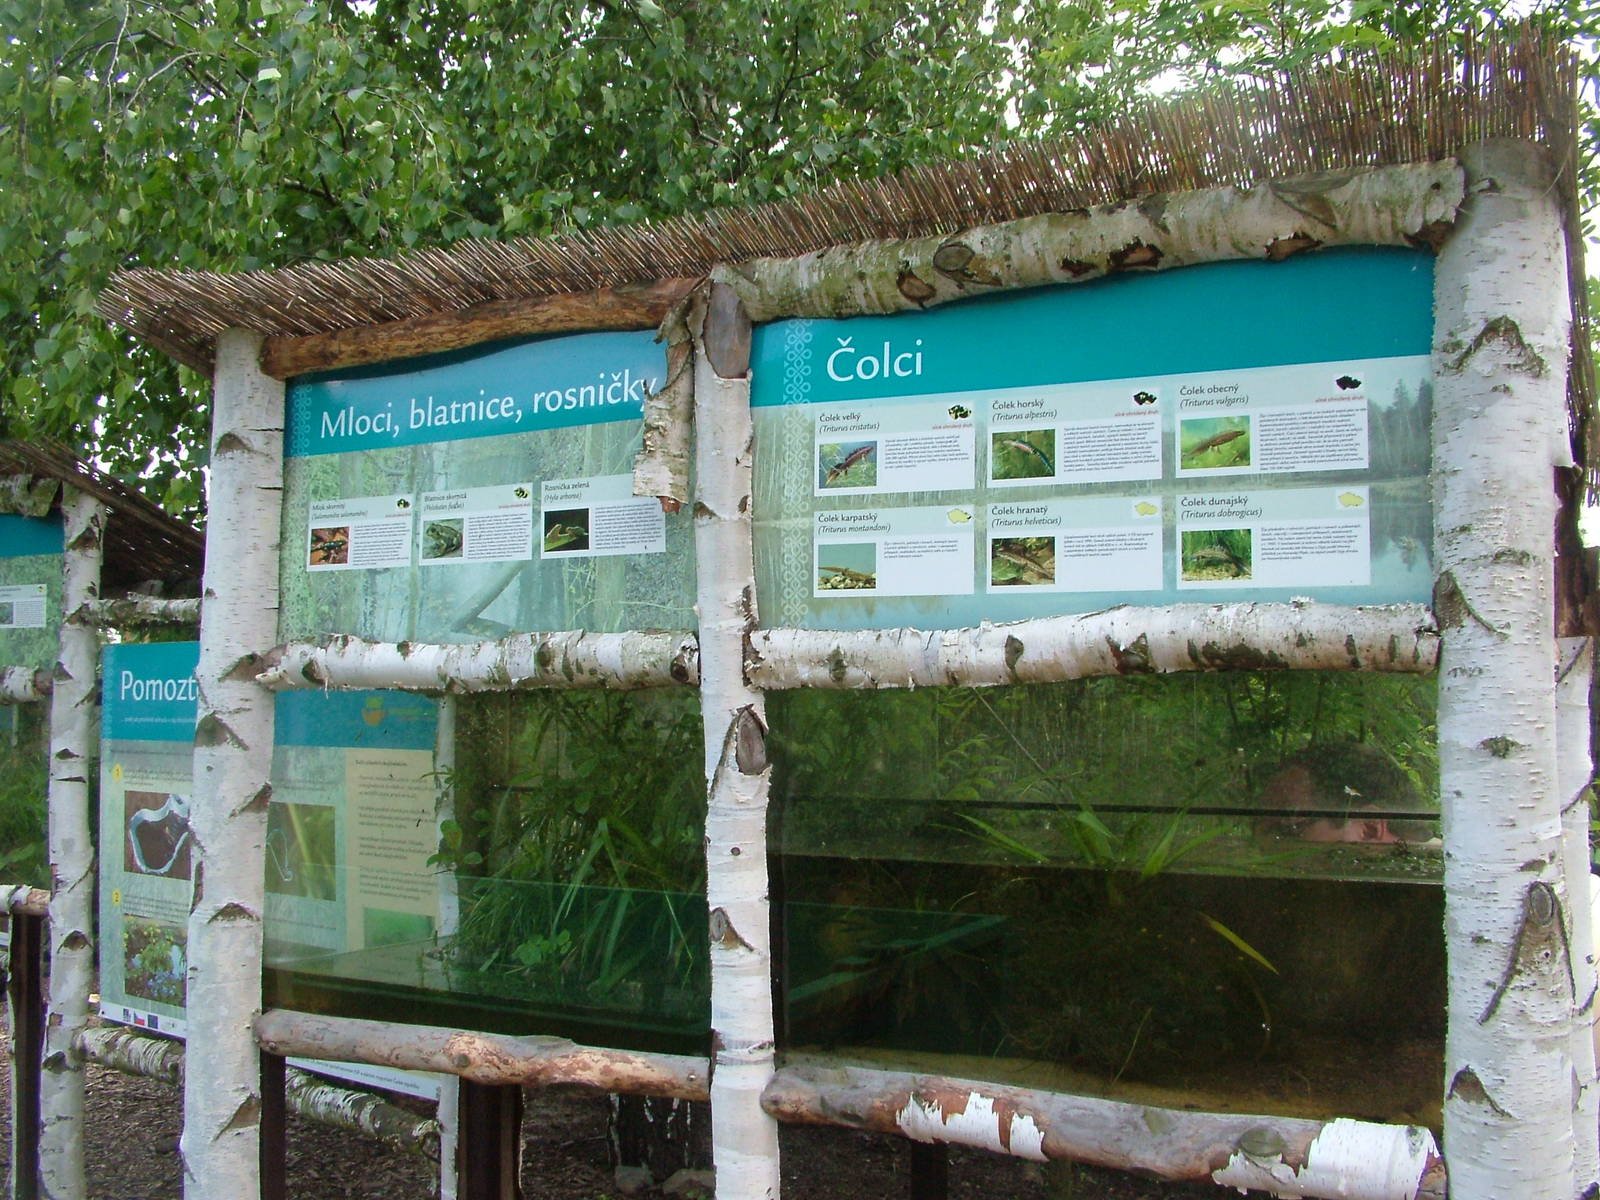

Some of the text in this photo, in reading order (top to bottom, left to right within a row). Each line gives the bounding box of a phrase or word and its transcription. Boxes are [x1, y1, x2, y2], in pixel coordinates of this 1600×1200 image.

[826, 335, 923, 382] Čolci
[1180, 383, 1239, 396] Čolek obecný
[320, 368, 657, 438] Mloci, blatnice, rosničky
[992, 398, 1044, 410] Čolek horský
[1179, 397, 1214, 409] (Triturus
[819, 412, 840, 422] Čolek
[992, 409, 1058, 423] (Triturus alpestris)
[1181, 495, 1248, 507] Čolek dunajský
[992, 505, 1048, 516] Čolek hranatý
[1181, 508, 1263, 520] (Triturus dobrogicus)
[818, 512, 878, 523] Čolek karpatský
[992, 516, 1062, 528] (Triturus helveticus)
[818, 525, 847, 535] (Triturus
[121, 670, 200, 701] Pomozt
